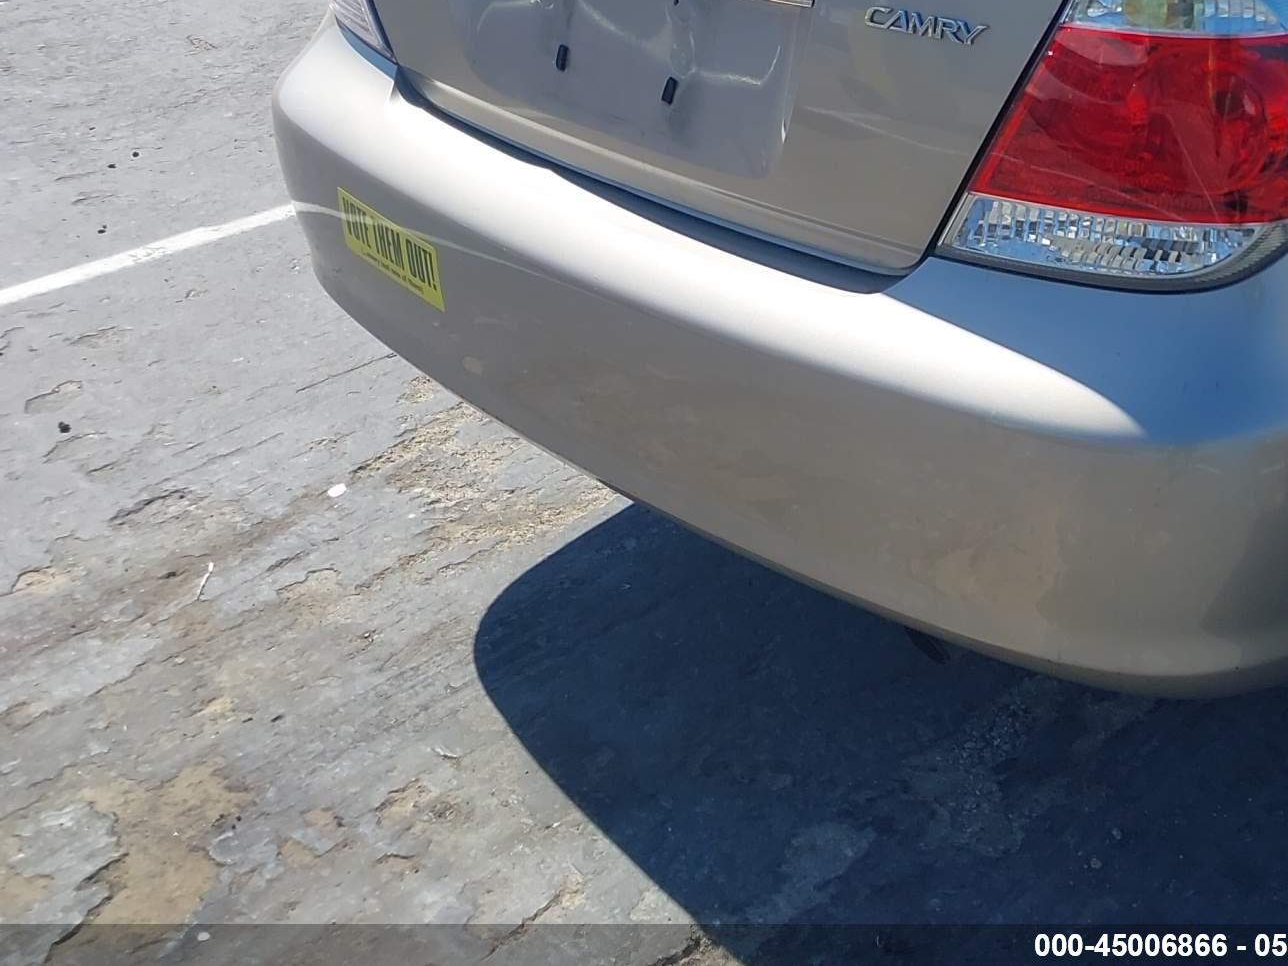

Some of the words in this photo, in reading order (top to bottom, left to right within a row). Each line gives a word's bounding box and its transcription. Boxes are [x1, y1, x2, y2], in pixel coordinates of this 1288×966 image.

[864, 6, 990, 46] CAMRY
[367, 215, 405, 271] THEM
[405, 238, 437, 291] OUT!
